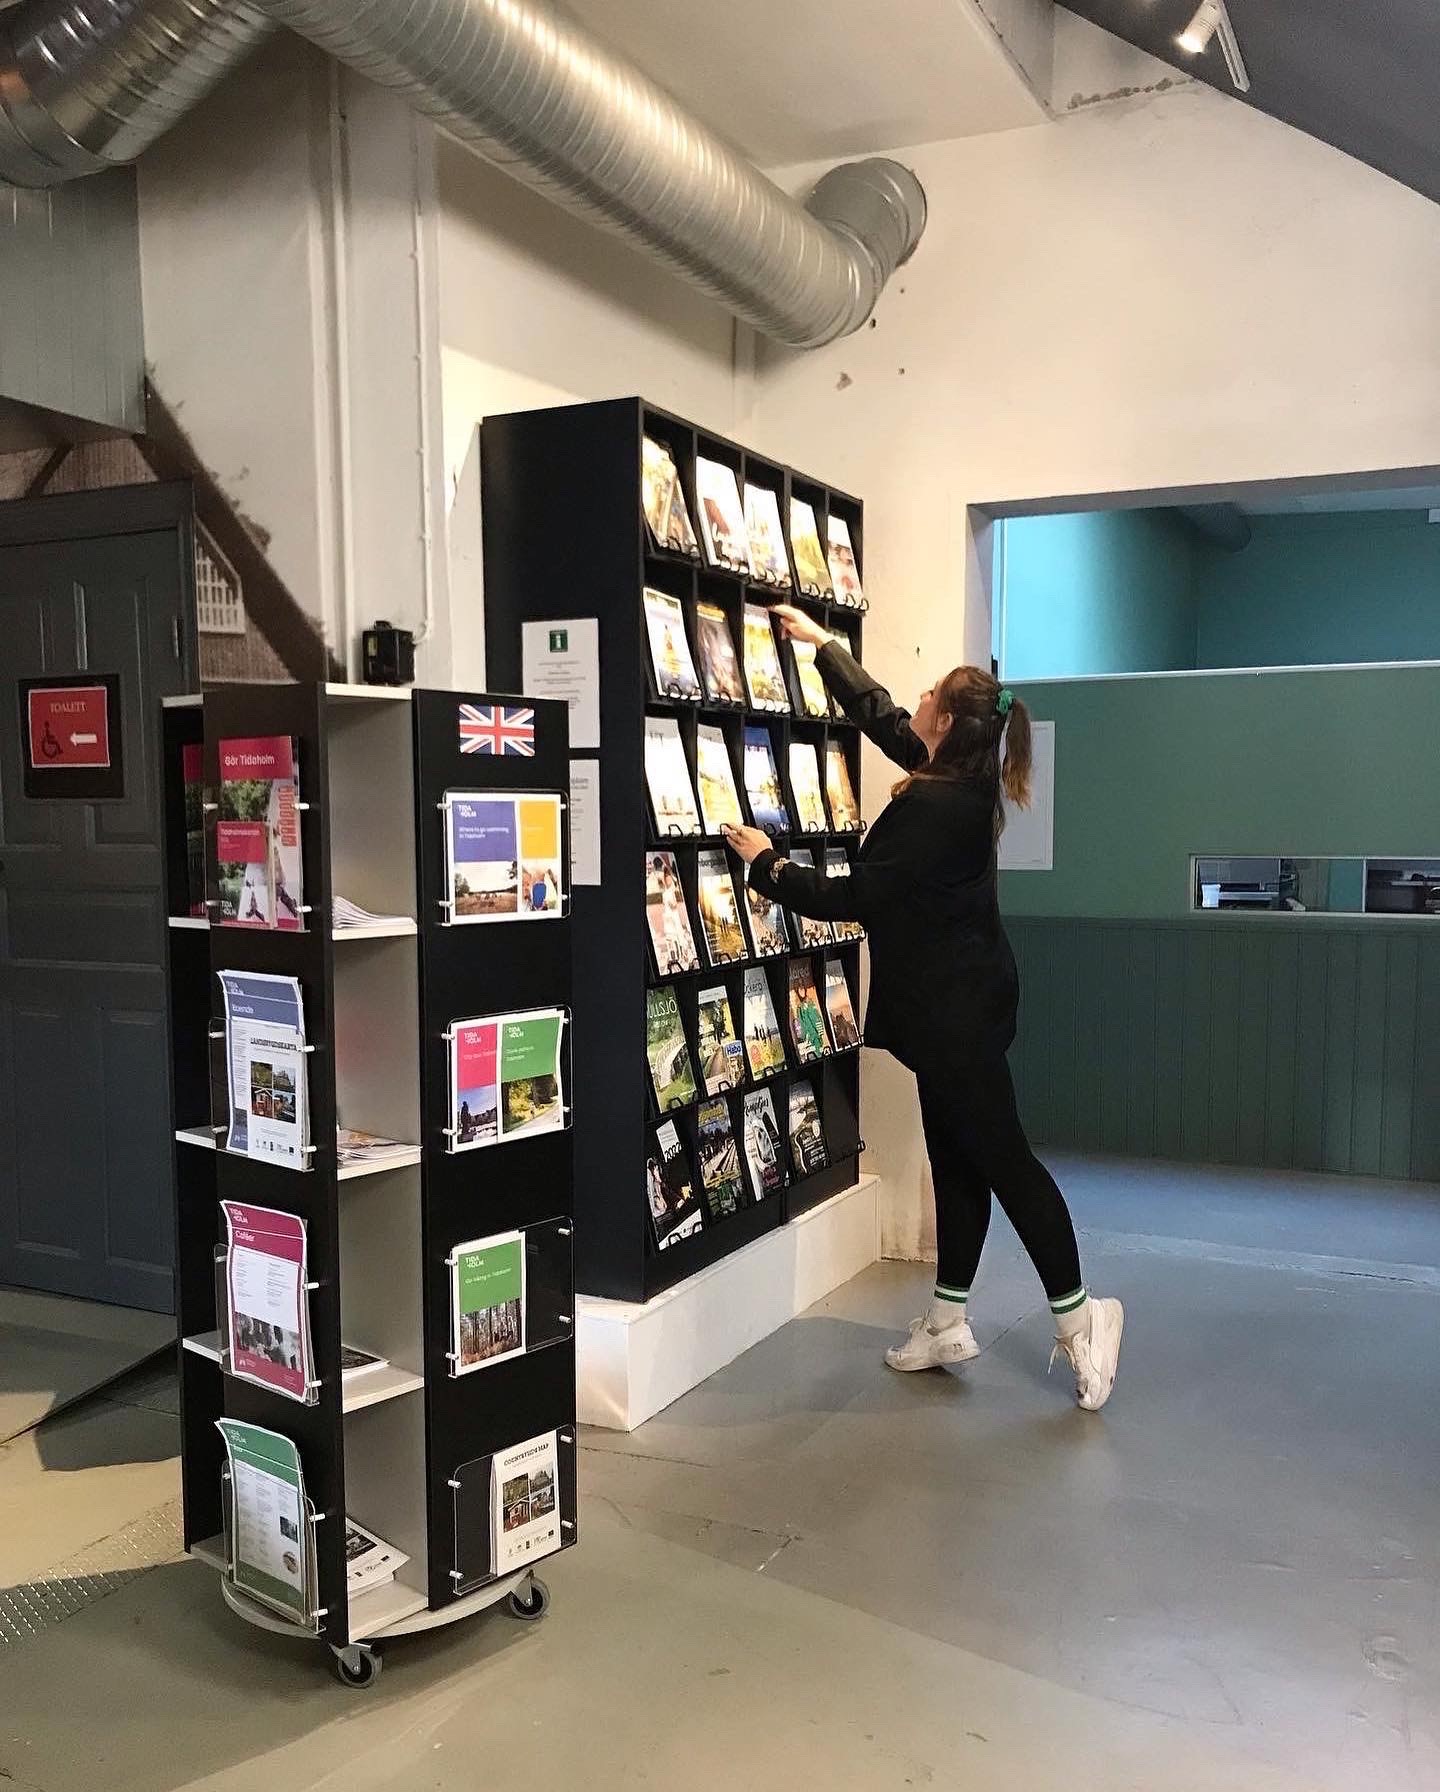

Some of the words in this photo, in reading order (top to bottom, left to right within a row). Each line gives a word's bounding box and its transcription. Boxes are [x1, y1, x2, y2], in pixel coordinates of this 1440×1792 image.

[50, 701, 87, 713] TOALETT
[225, 755, 239, 766] Gör
[240, 754, 275, 765] Tidaholm
